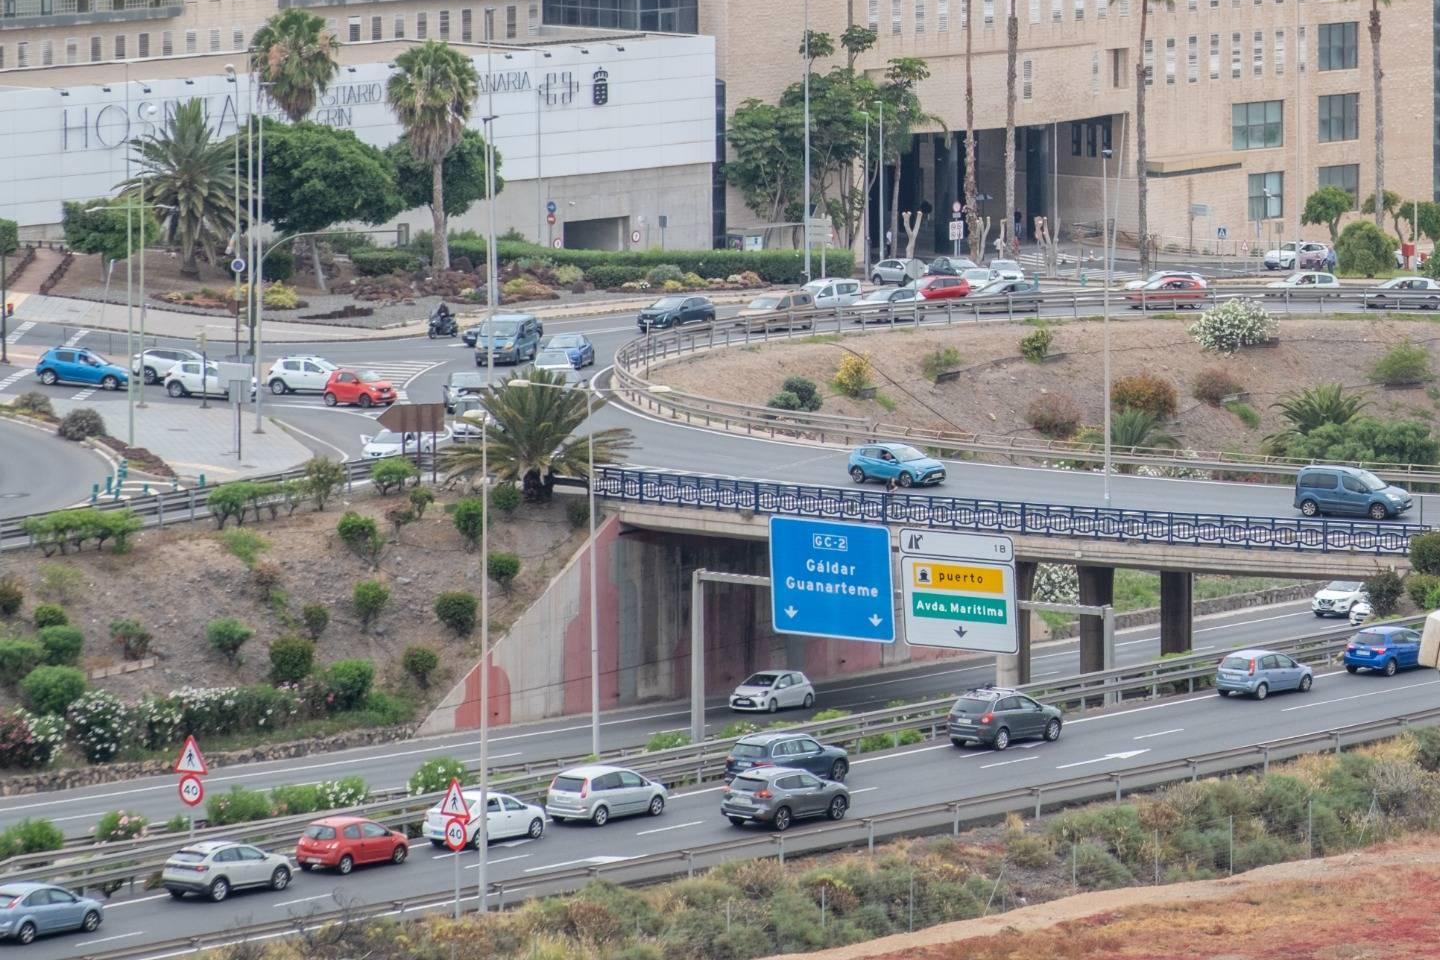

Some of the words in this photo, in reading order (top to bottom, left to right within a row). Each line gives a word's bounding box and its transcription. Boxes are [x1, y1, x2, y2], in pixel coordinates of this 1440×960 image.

[815, 535, 846, 549] GC-2
[806, 558, 856, 576] Gáldar
[939, 572, 983, 584] puerto
[785, 576, 879, 597] Guanarteme
[916, 600, 947, 612] Avda.
[183, 784, 198, 796] 40
[448, 828, 462, 839] 40
